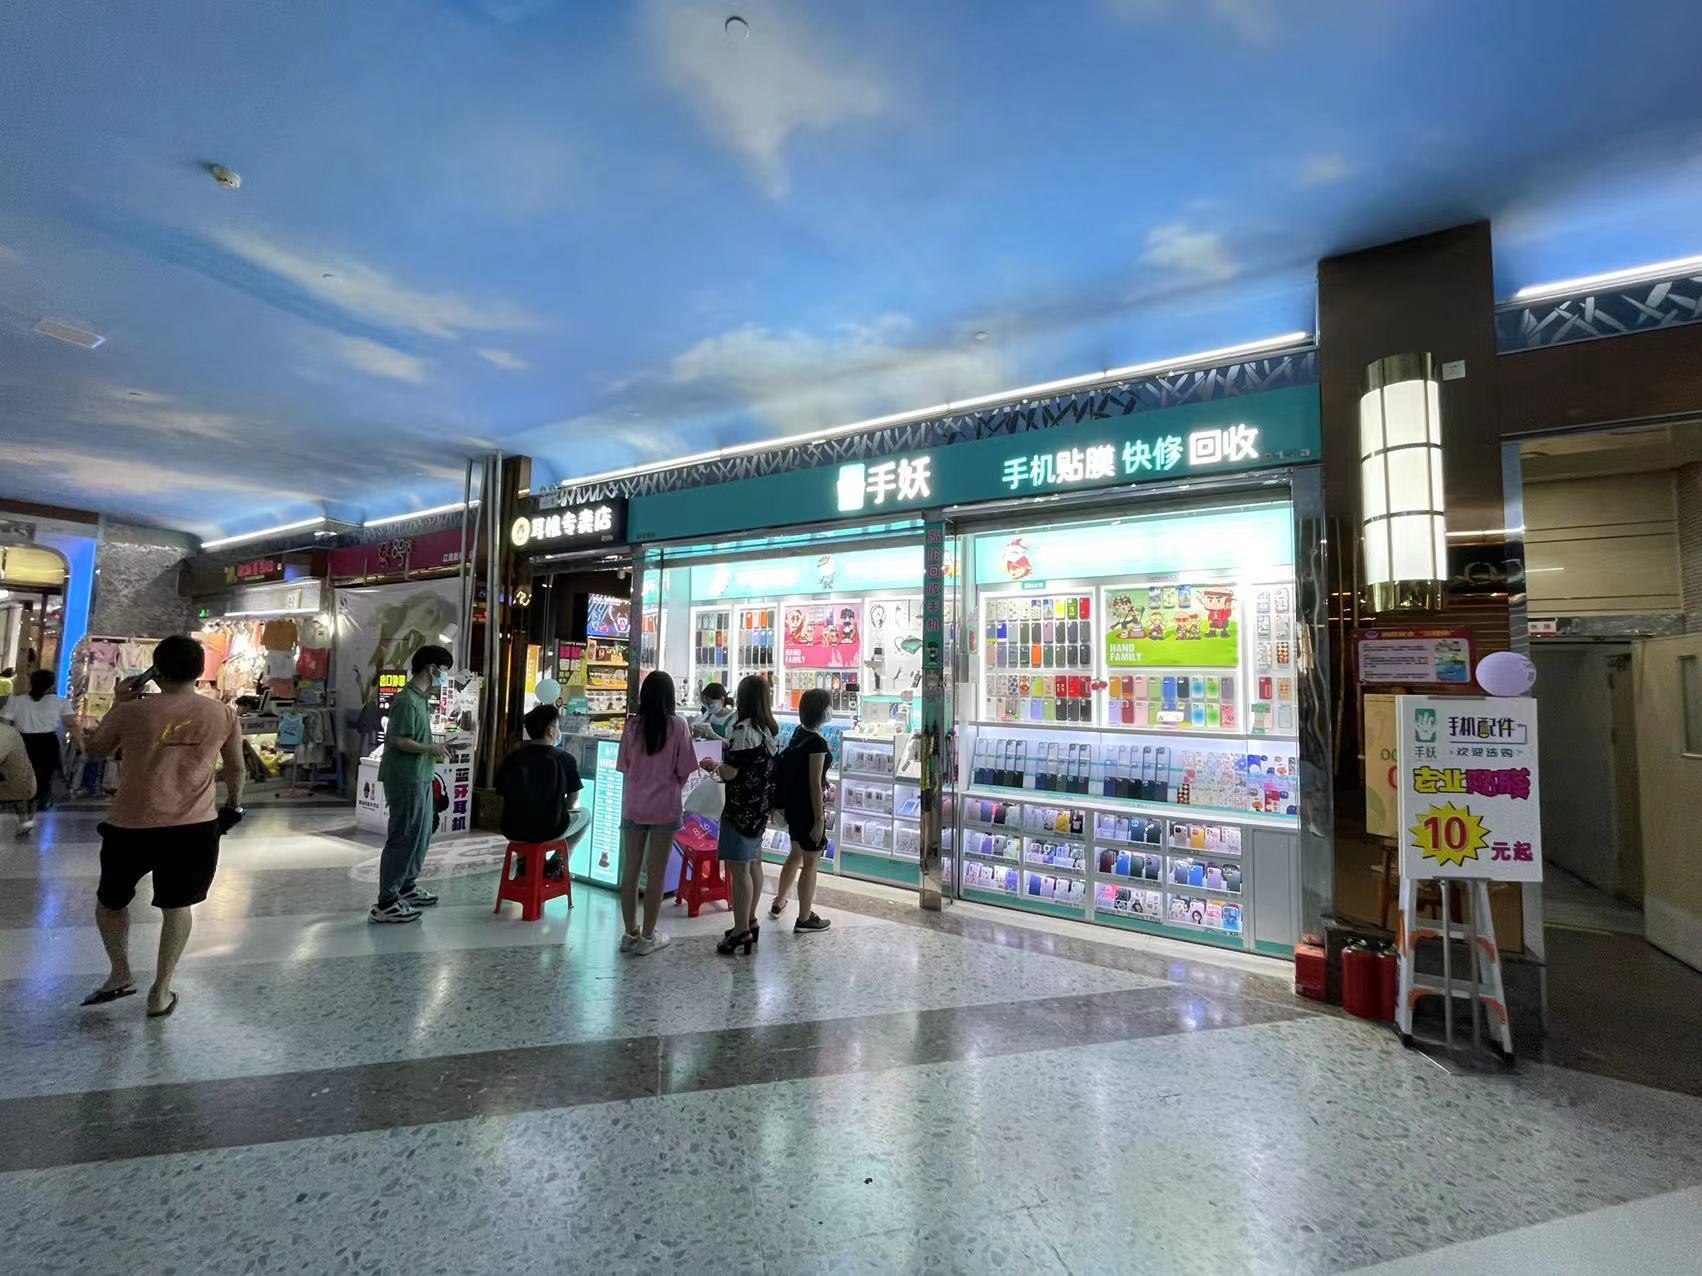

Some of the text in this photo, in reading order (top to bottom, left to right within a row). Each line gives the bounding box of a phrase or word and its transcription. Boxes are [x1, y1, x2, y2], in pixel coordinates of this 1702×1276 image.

[1002, 423, 1259, 490] 手机贴膜 快修 回收
[866, 456, 931, 504] 手妖
[1110, 643, 1135, 652] HAND
[1110, 652, 1143, 662] FAMILY
[785, 655, 806, 664] FAMILY
[1448, 716, 1515, 739] 手机配件
[1415, 746, 1437, 760] 手妖
[1456, 747, 1514, 758] 欢迎选购
[452, 767, 470, 832] 蓝牙耳机
[1423, 816, 1468, 851] 10
[1491, 841, 1534, 862] 元起
